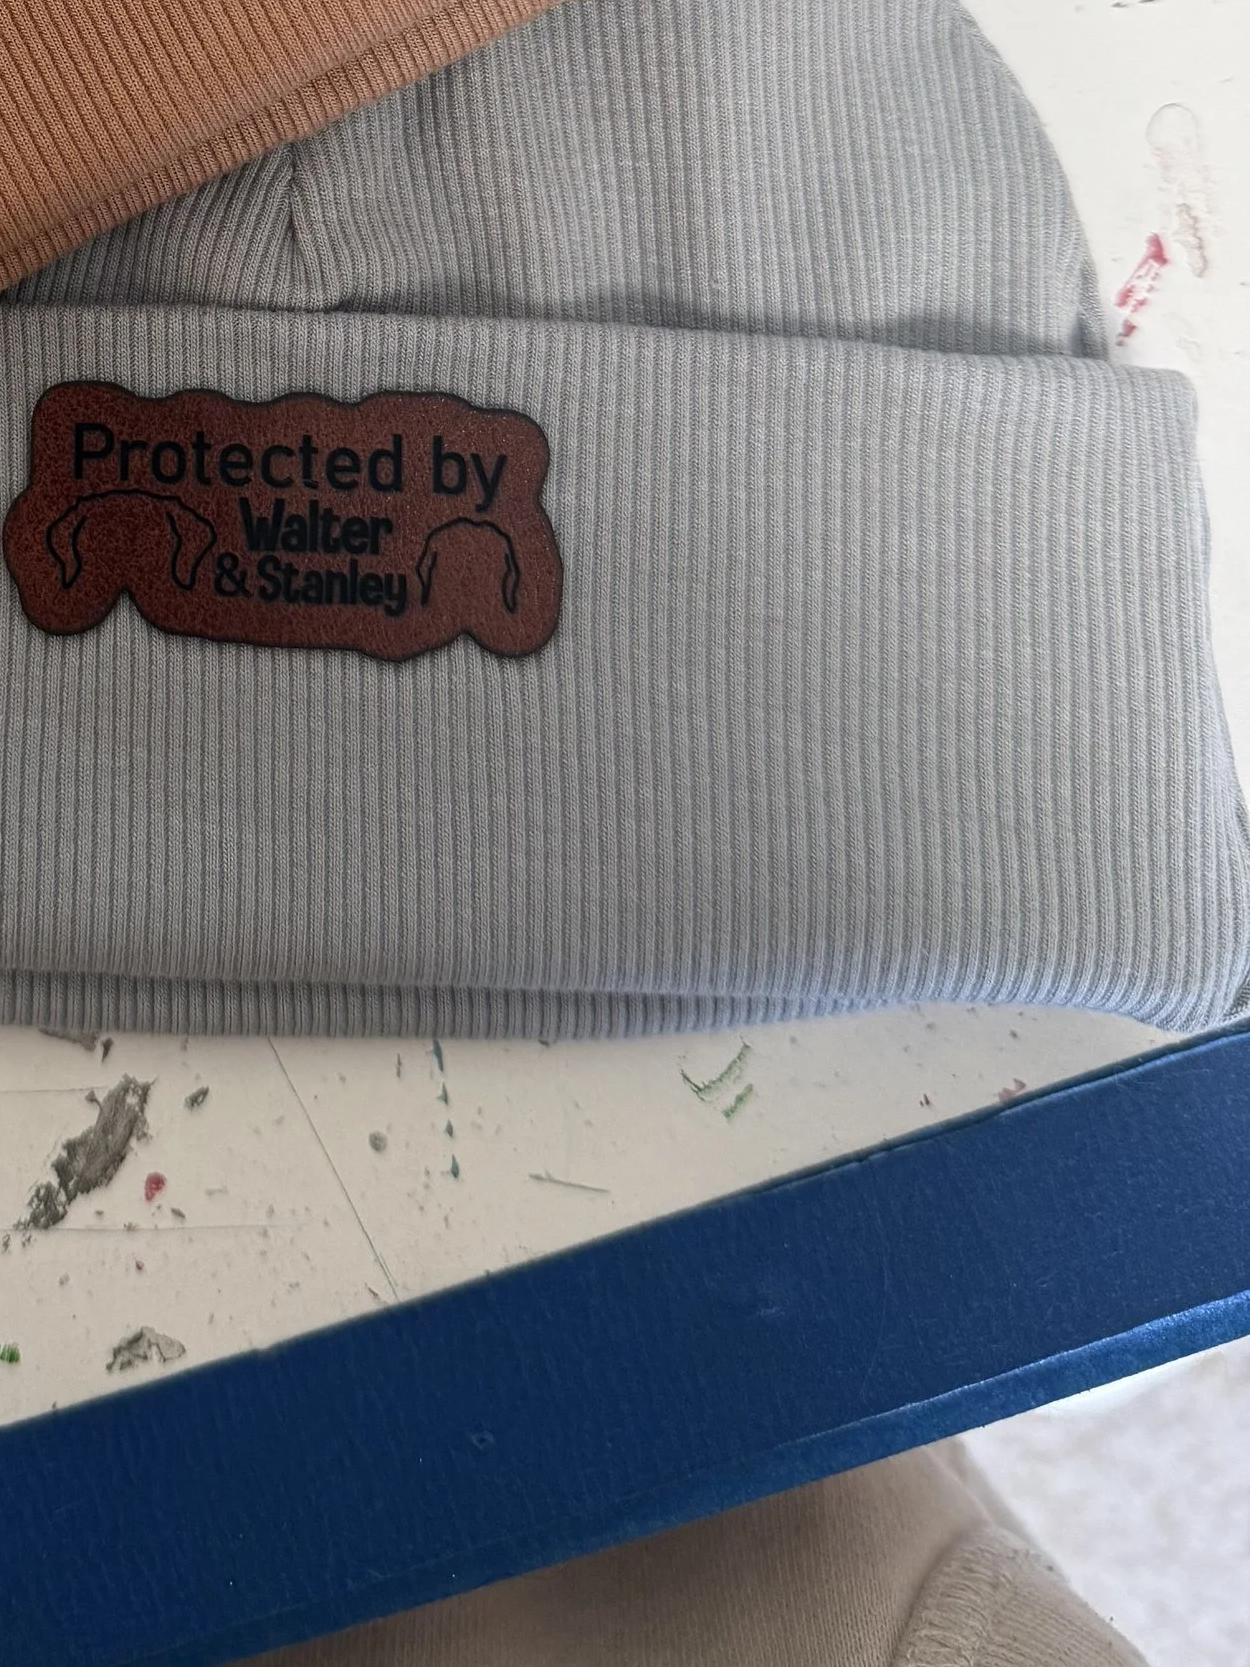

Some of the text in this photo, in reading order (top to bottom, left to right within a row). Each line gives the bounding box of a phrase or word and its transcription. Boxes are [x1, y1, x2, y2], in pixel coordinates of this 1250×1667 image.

[73, 422, 507, 512] Protected by
[239, 497, 394, 555] Walter
